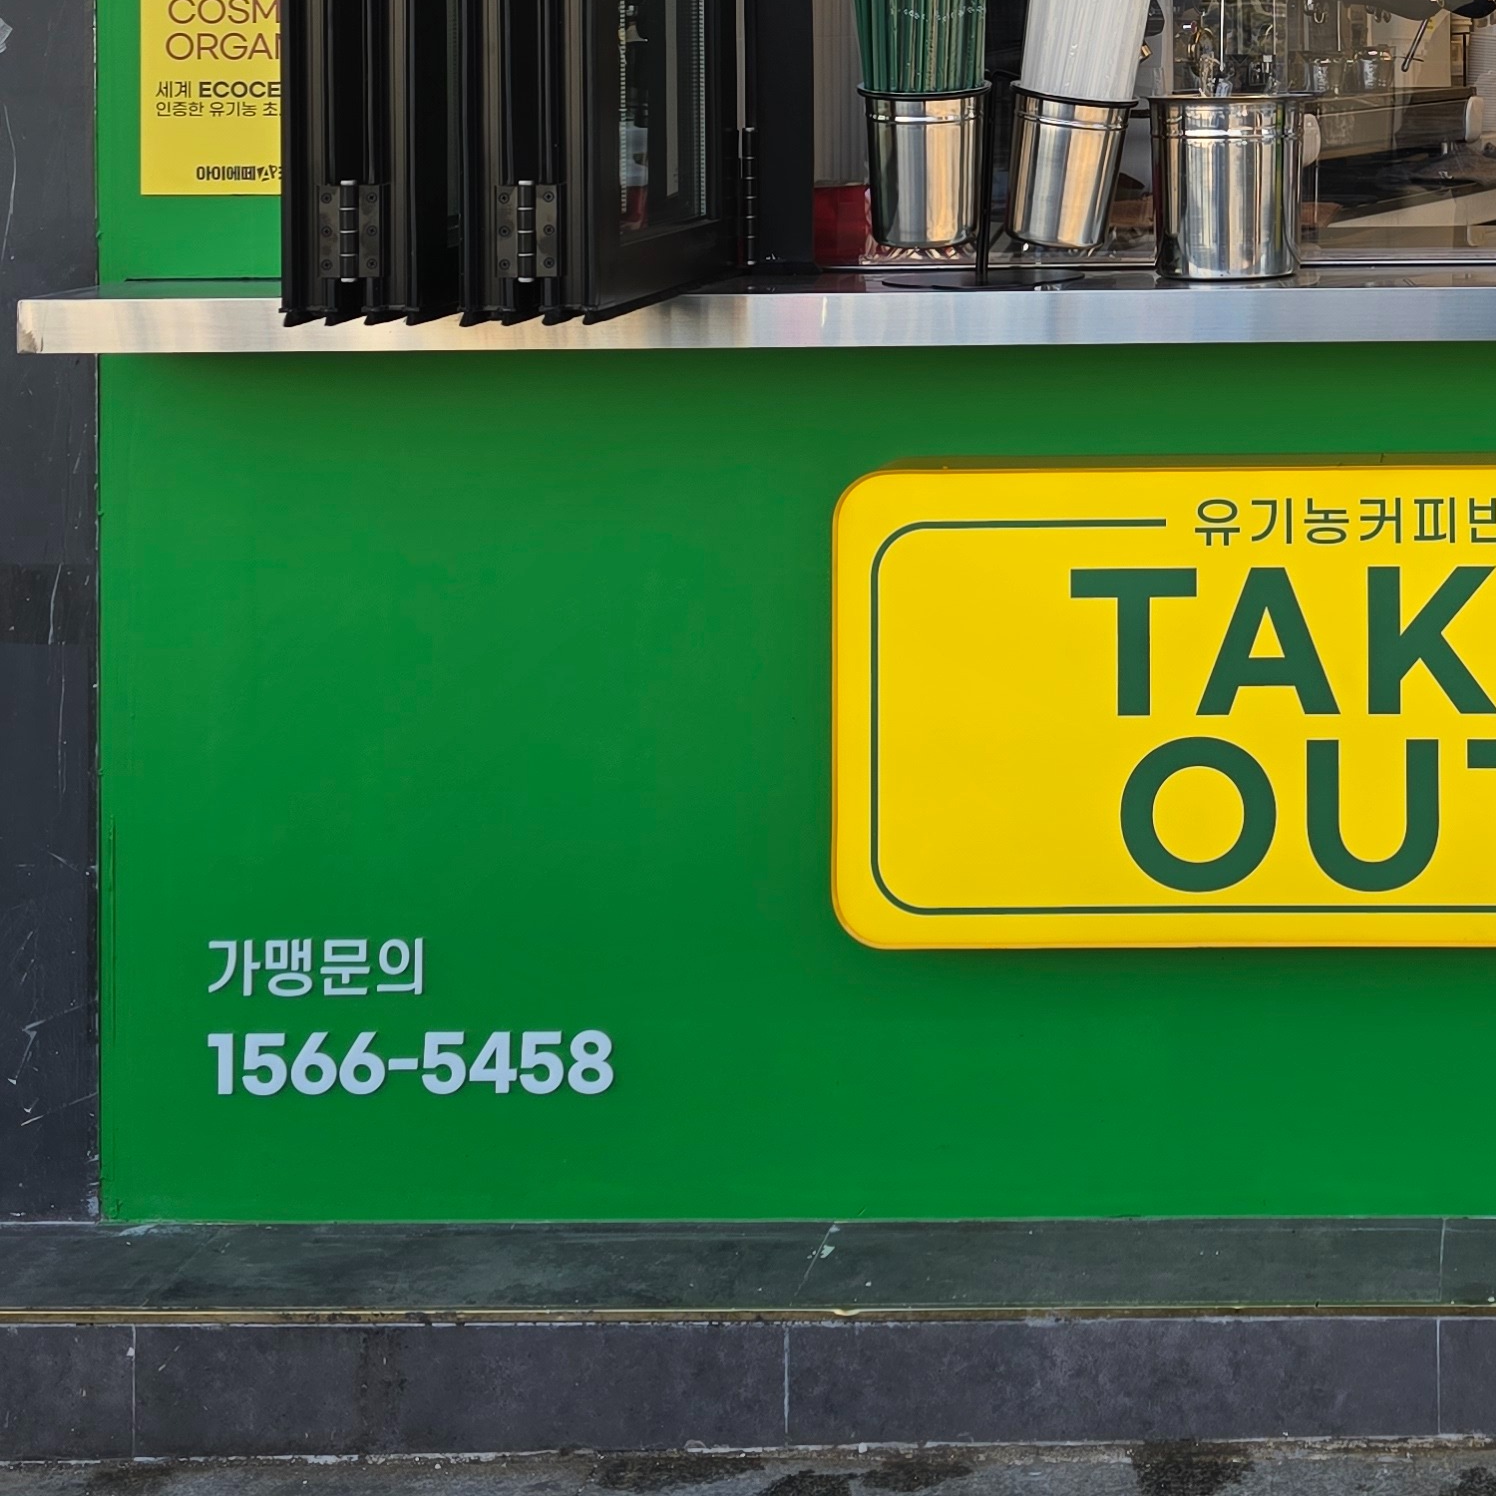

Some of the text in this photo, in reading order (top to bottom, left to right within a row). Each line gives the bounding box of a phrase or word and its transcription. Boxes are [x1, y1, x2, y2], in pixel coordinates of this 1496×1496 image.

[166, 33, 280, 60] ORGA
[156, 81, 191, 98] 세계
[156, 102, 281, 116] 인증한 유기농 초
[196, 166, 255, 180] 아이에떼
[207, 937, 424, 997] 가맹문의
[207, 1030, 614, 1096] 1566-5458
